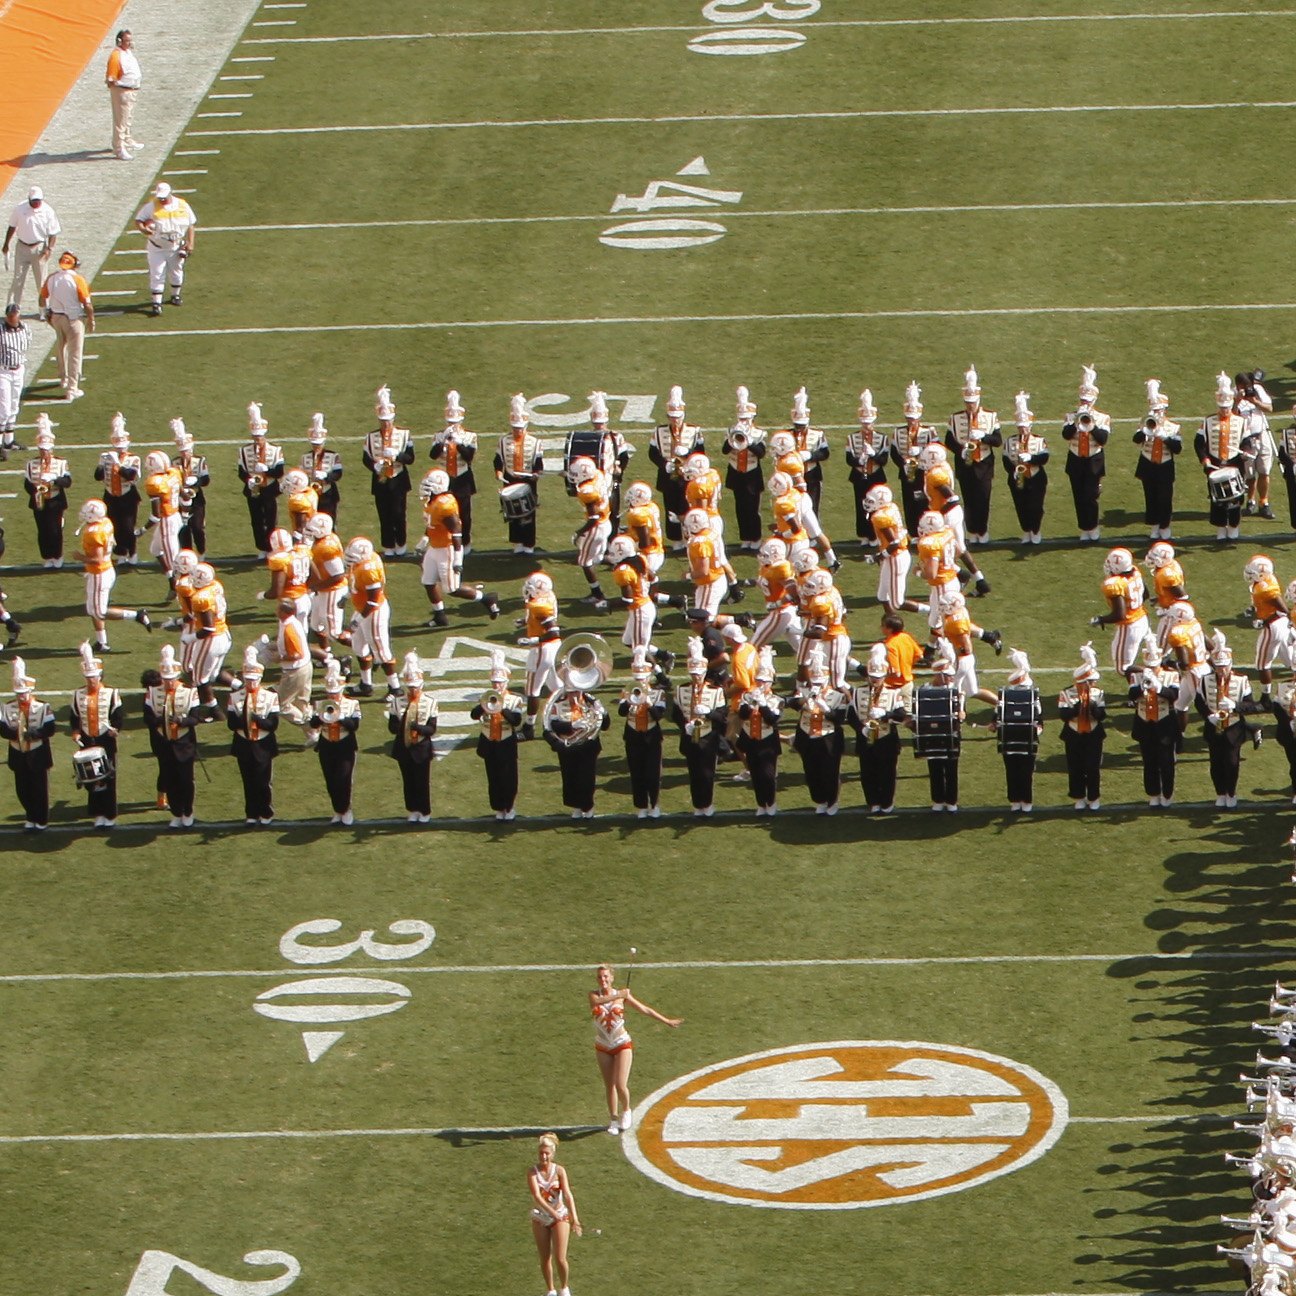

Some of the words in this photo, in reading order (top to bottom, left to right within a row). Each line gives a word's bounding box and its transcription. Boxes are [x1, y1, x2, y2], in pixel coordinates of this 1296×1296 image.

[686, 0, 822, 55] 30
[599, 180, 742, 250] 40
[252, 918, 436, 1024] 30
[662, 1052, 1031, 1195] SEC
